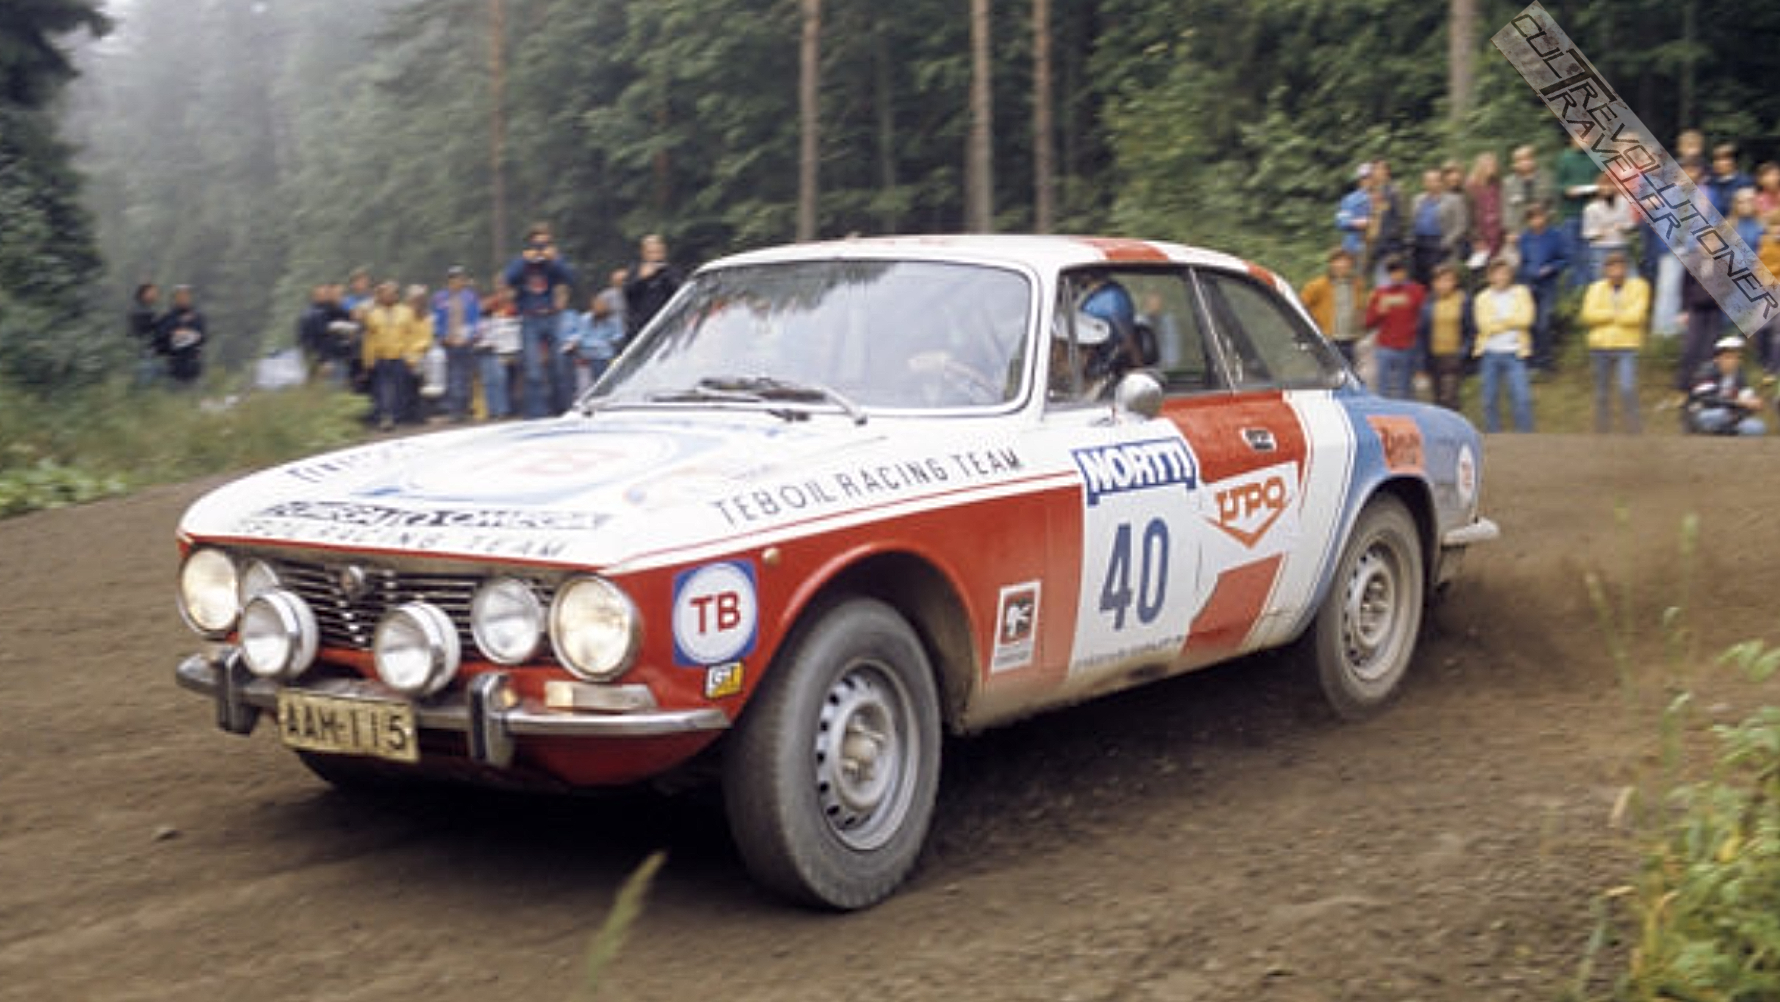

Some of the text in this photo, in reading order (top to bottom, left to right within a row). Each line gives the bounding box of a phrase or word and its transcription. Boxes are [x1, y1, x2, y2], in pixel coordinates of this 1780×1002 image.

[713, 448, 1031, 527] TEBOIL RACING TEAM
[1099, 516, 1170, 631] 40
[690, 590, 742, 634] TB
[285, 701, 408, 751] AAM-115
